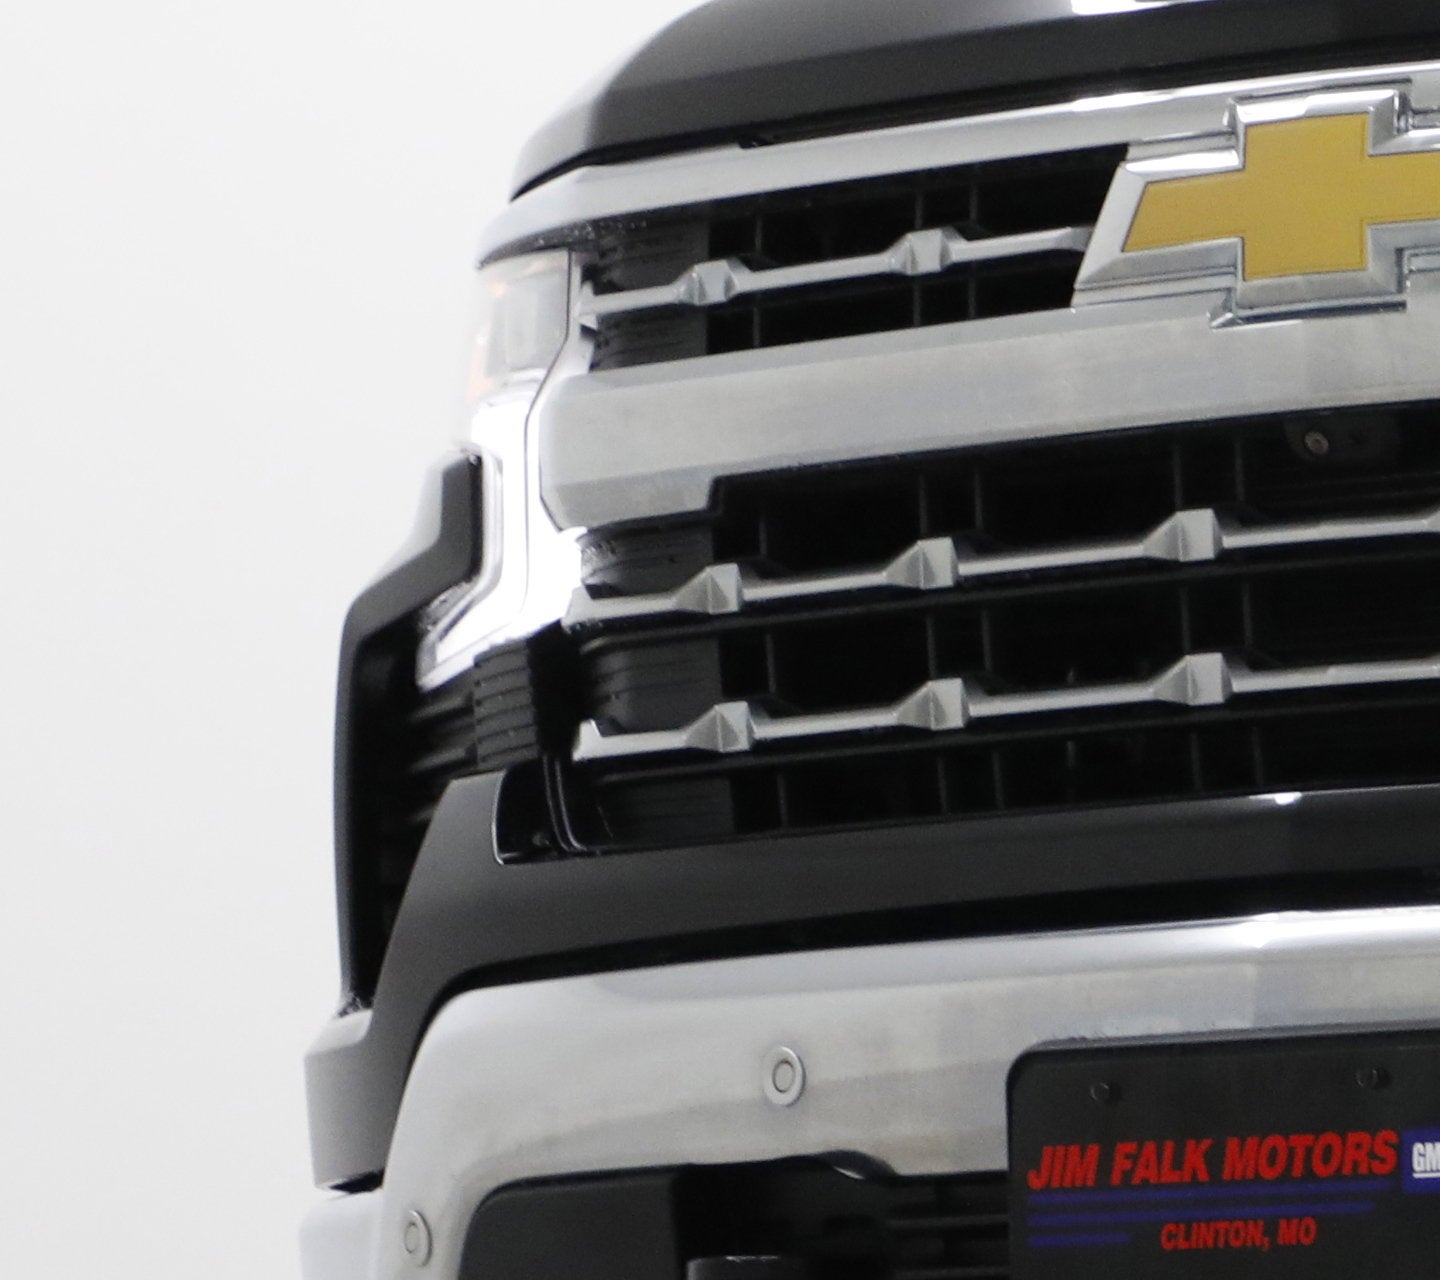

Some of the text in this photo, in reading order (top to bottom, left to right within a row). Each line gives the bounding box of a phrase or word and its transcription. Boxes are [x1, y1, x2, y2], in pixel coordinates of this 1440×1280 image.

[1028, 1129, 1399, 1190] JIM FALK MOTORS
[1161, 1217, 1318, 1251] CLINTON, MO
